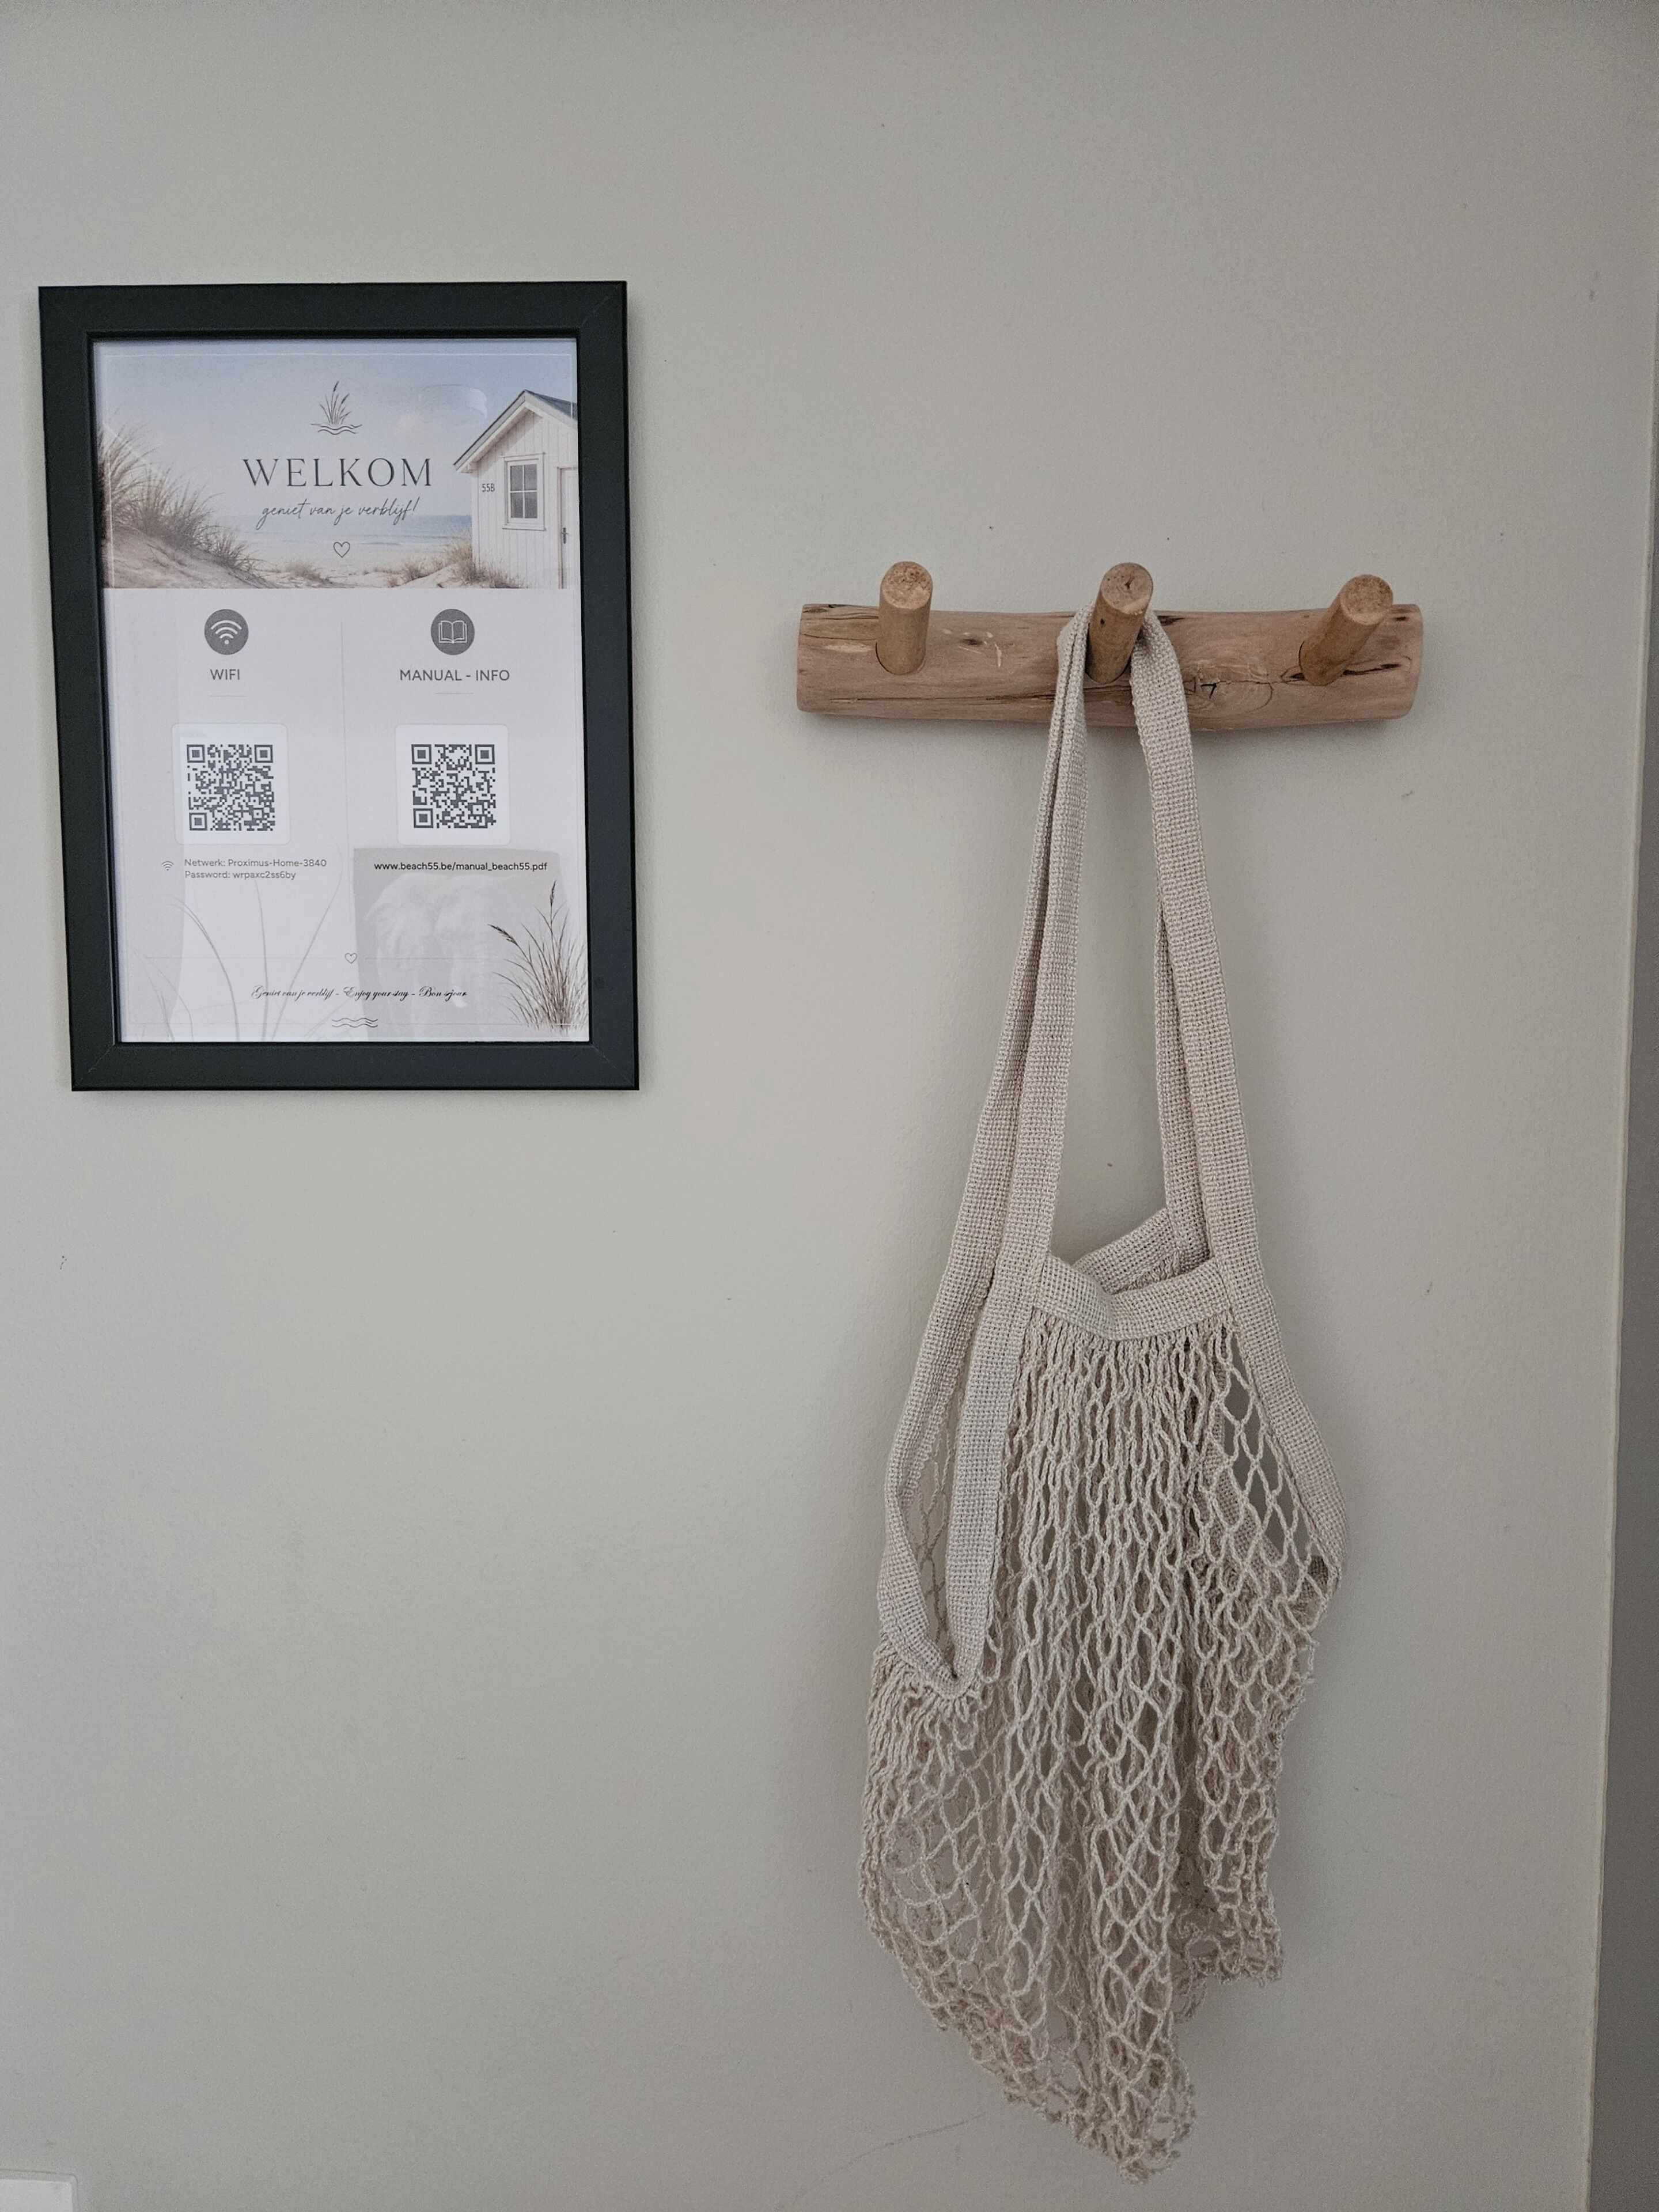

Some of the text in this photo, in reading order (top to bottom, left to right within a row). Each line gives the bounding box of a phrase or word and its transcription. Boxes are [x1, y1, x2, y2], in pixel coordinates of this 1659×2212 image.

[242, 457, 432, 487] WELKOM
[482, 483, 495, 493] 55B
[256, 497, 421, 531] geniet van je verblijf!
[210, 668, 240, 681] WIFI
[399, 669, 463, 681] MANUAL
[475, 669, 510, 682] INFO
[184, 859, 327, 868] Netwerk: Proximus-Home-3840
[374, 862, 548, 872] www.beach55.be/manual_beach55.pdf
[184, 870, 230, 879] Password:
